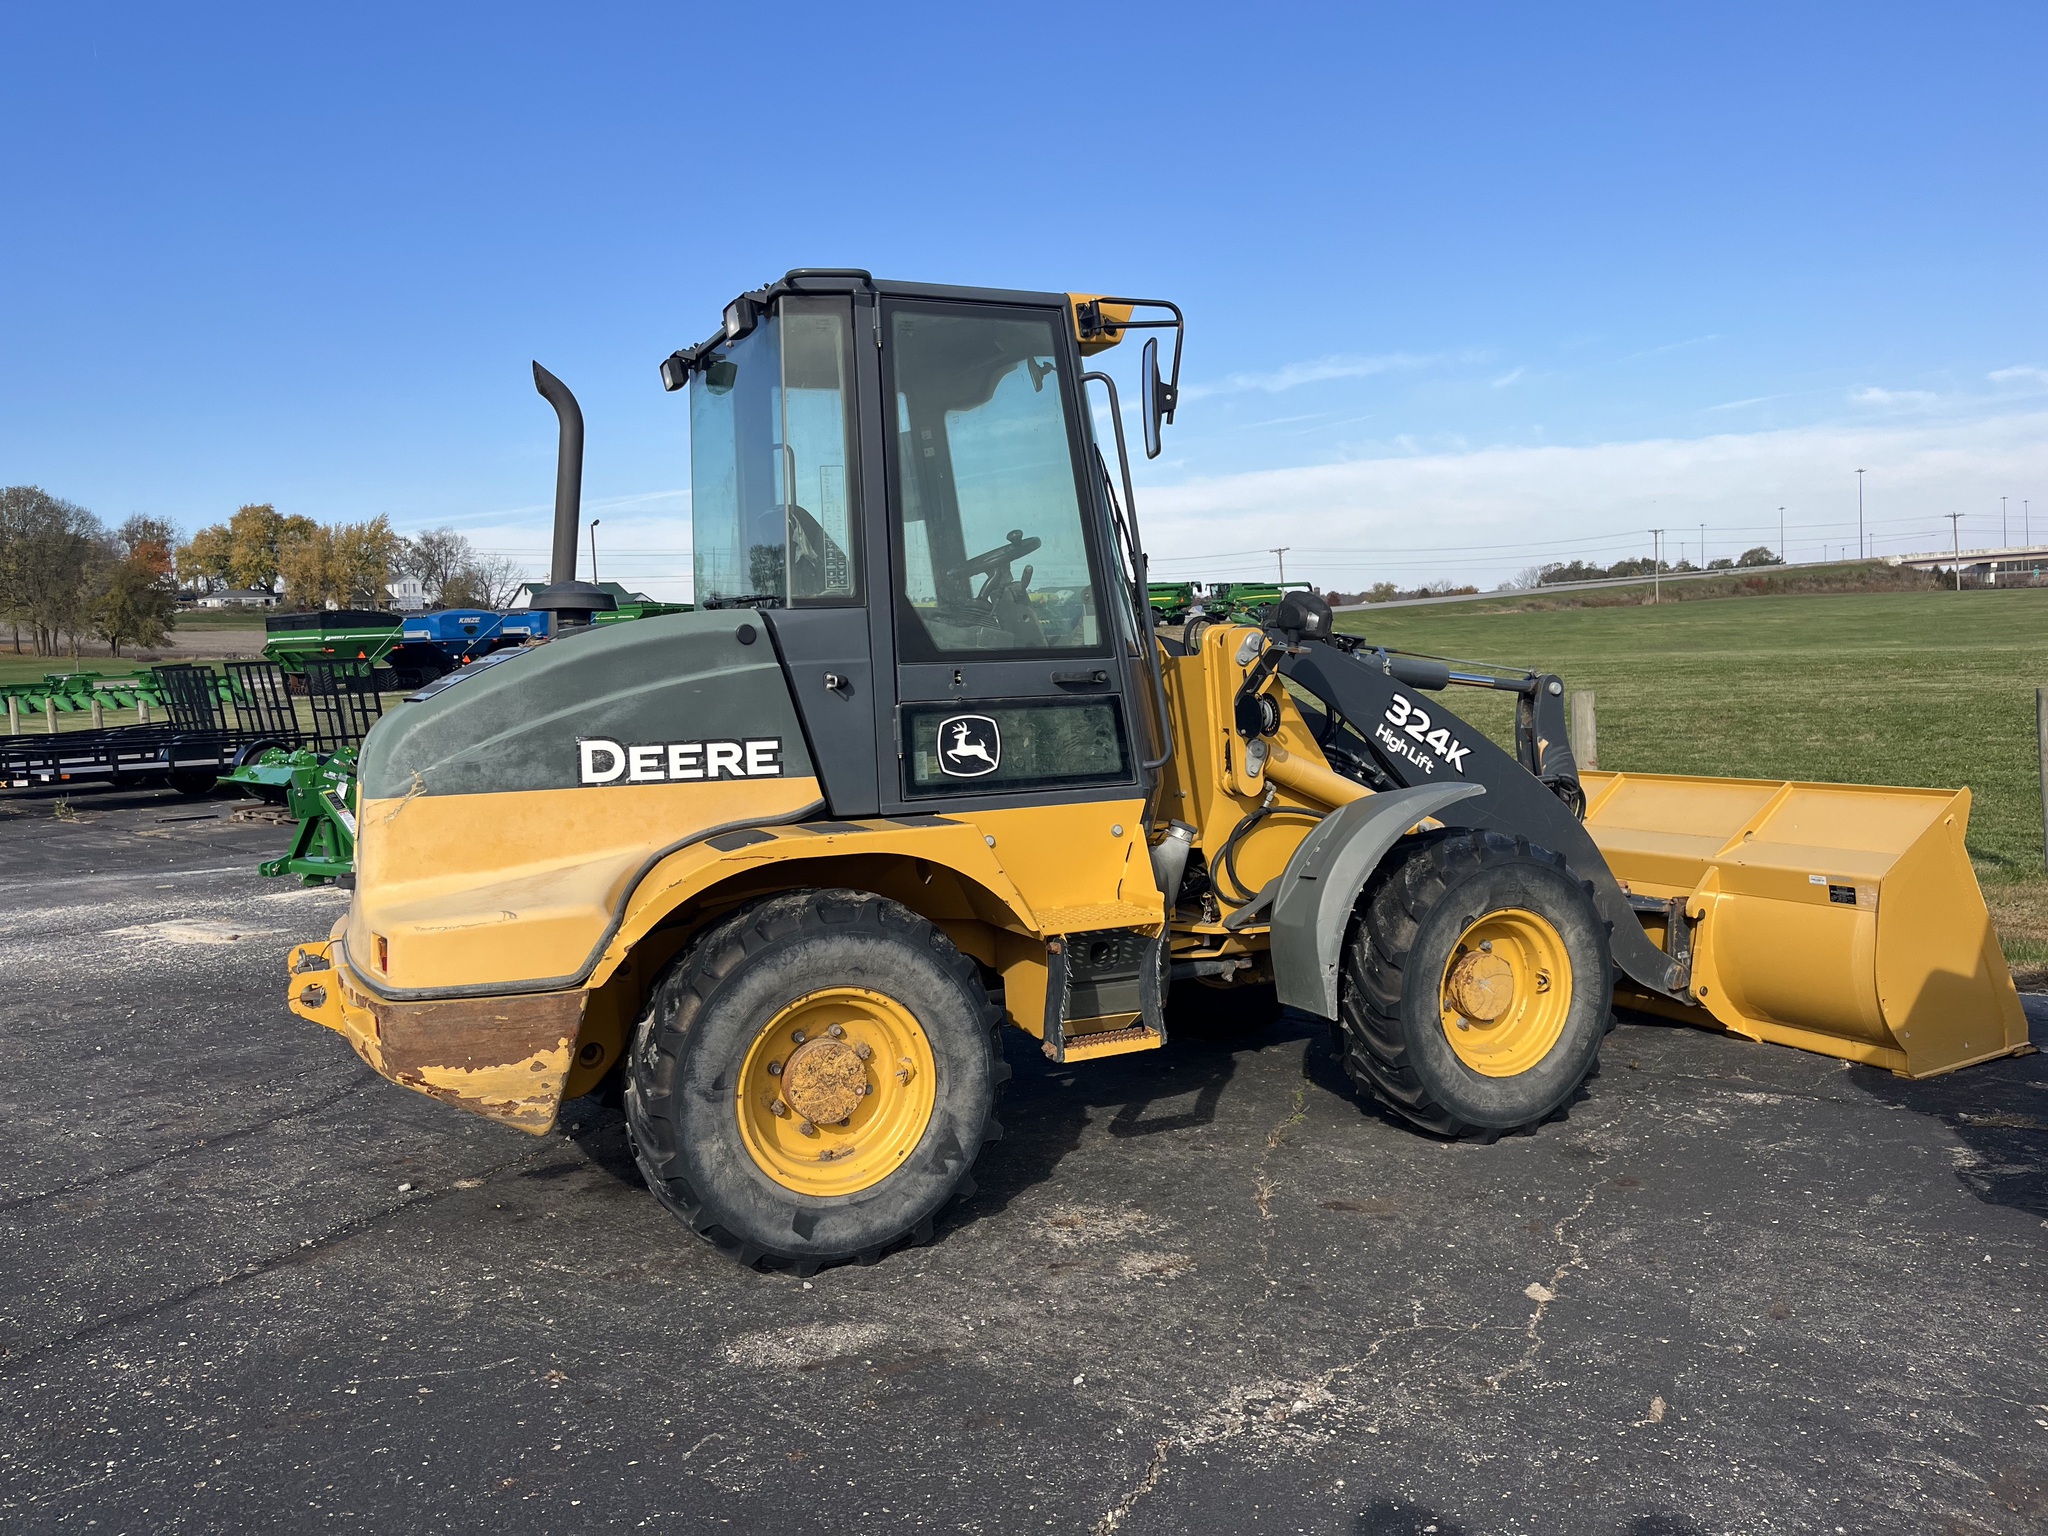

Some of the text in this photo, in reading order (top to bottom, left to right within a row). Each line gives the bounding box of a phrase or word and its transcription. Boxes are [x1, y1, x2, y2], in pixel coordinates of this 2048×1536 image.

[458, 616, 481, 624] KINZE
[1375, 723, 1434, 775] High Lift
[1385, 693, 1472, 773] 324K
[580, 740, 780, 784] DEERE
